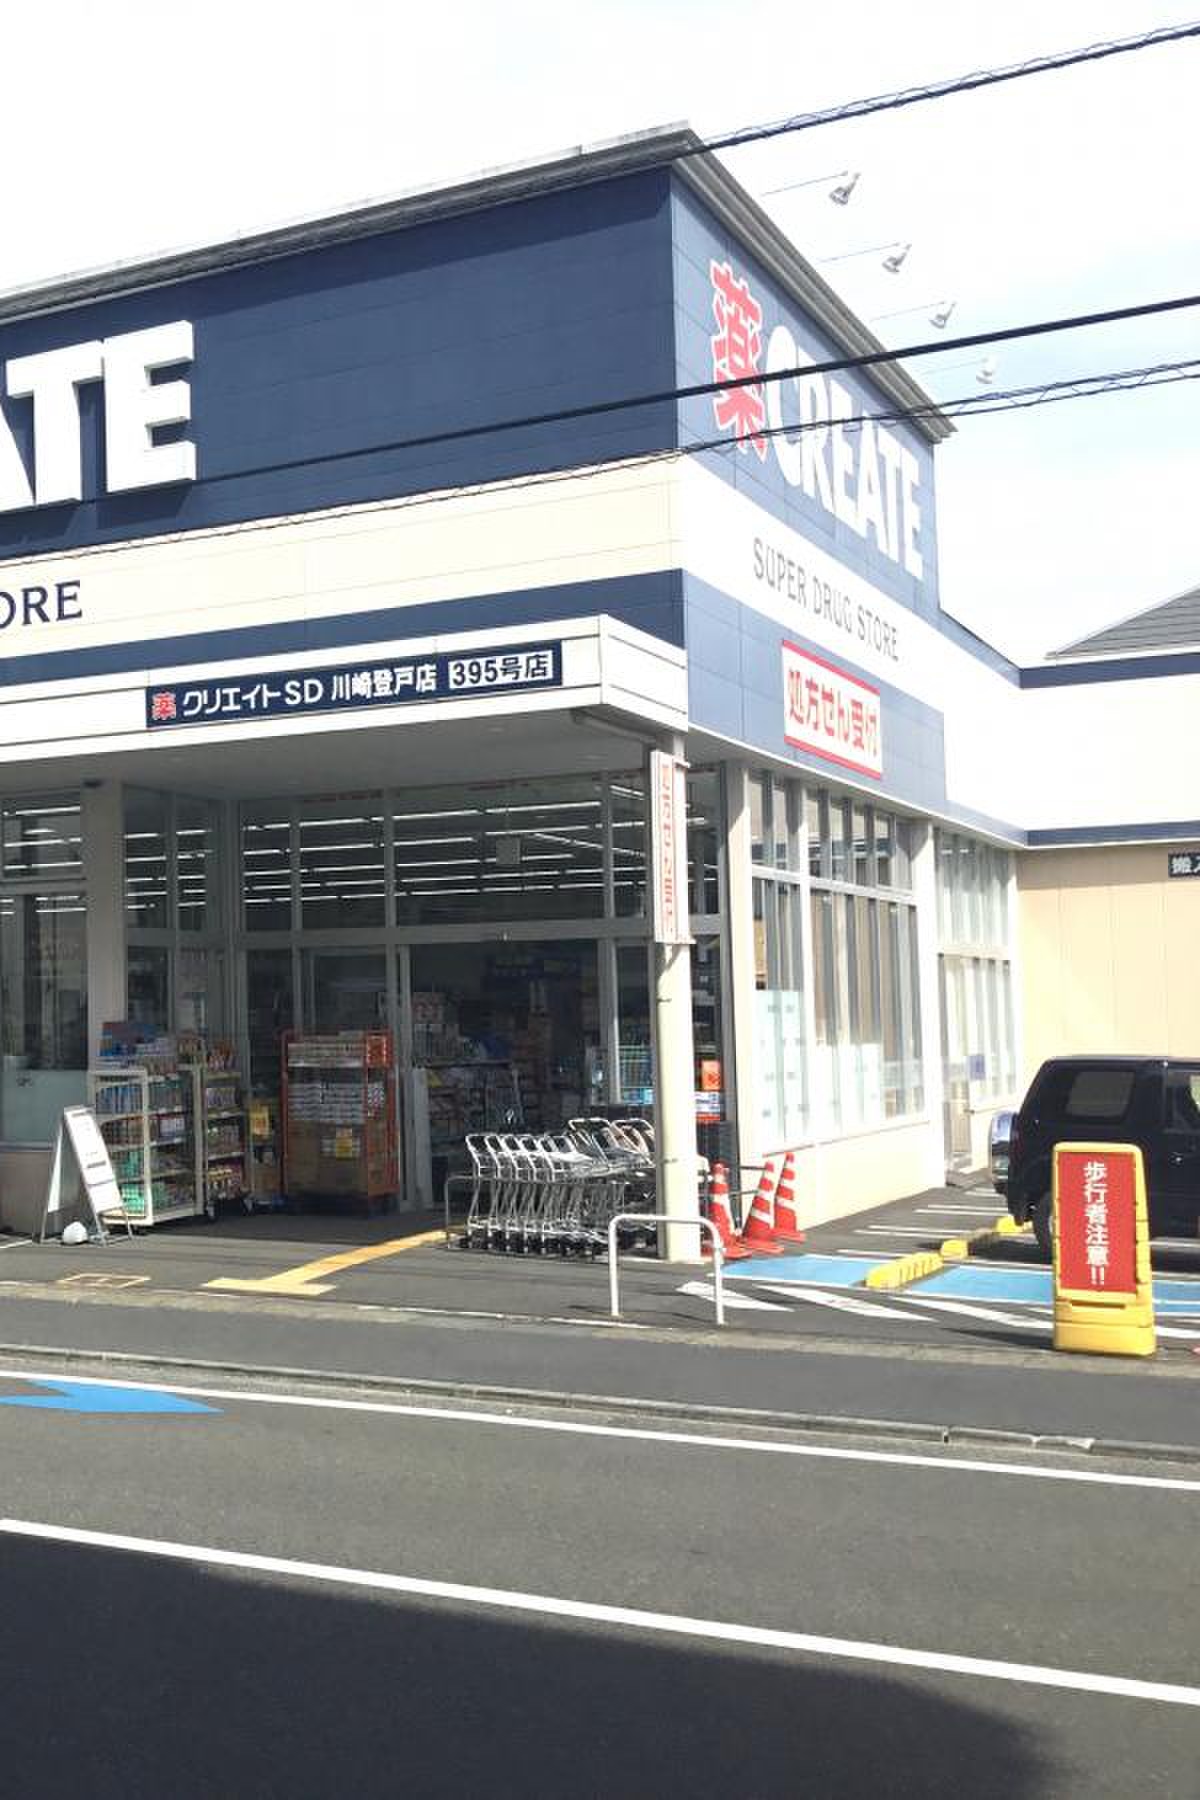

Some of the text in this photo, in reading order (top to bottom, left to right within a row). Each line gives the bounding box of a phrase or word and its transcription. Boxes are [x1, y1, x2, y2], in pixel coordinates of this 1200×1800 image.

[710, 259, 768, 464] 薬
[766, 325, 923, 581] CREATE
[753, 537, 899, 662] SUPER DRUG STORE
[151, 691, 177, 720] 薬
[331, 664, 438, 701] 川崎登戸店
[452, 653, 549, 687] 395号店
[787, 668, 877, 757] 処方せん受付
